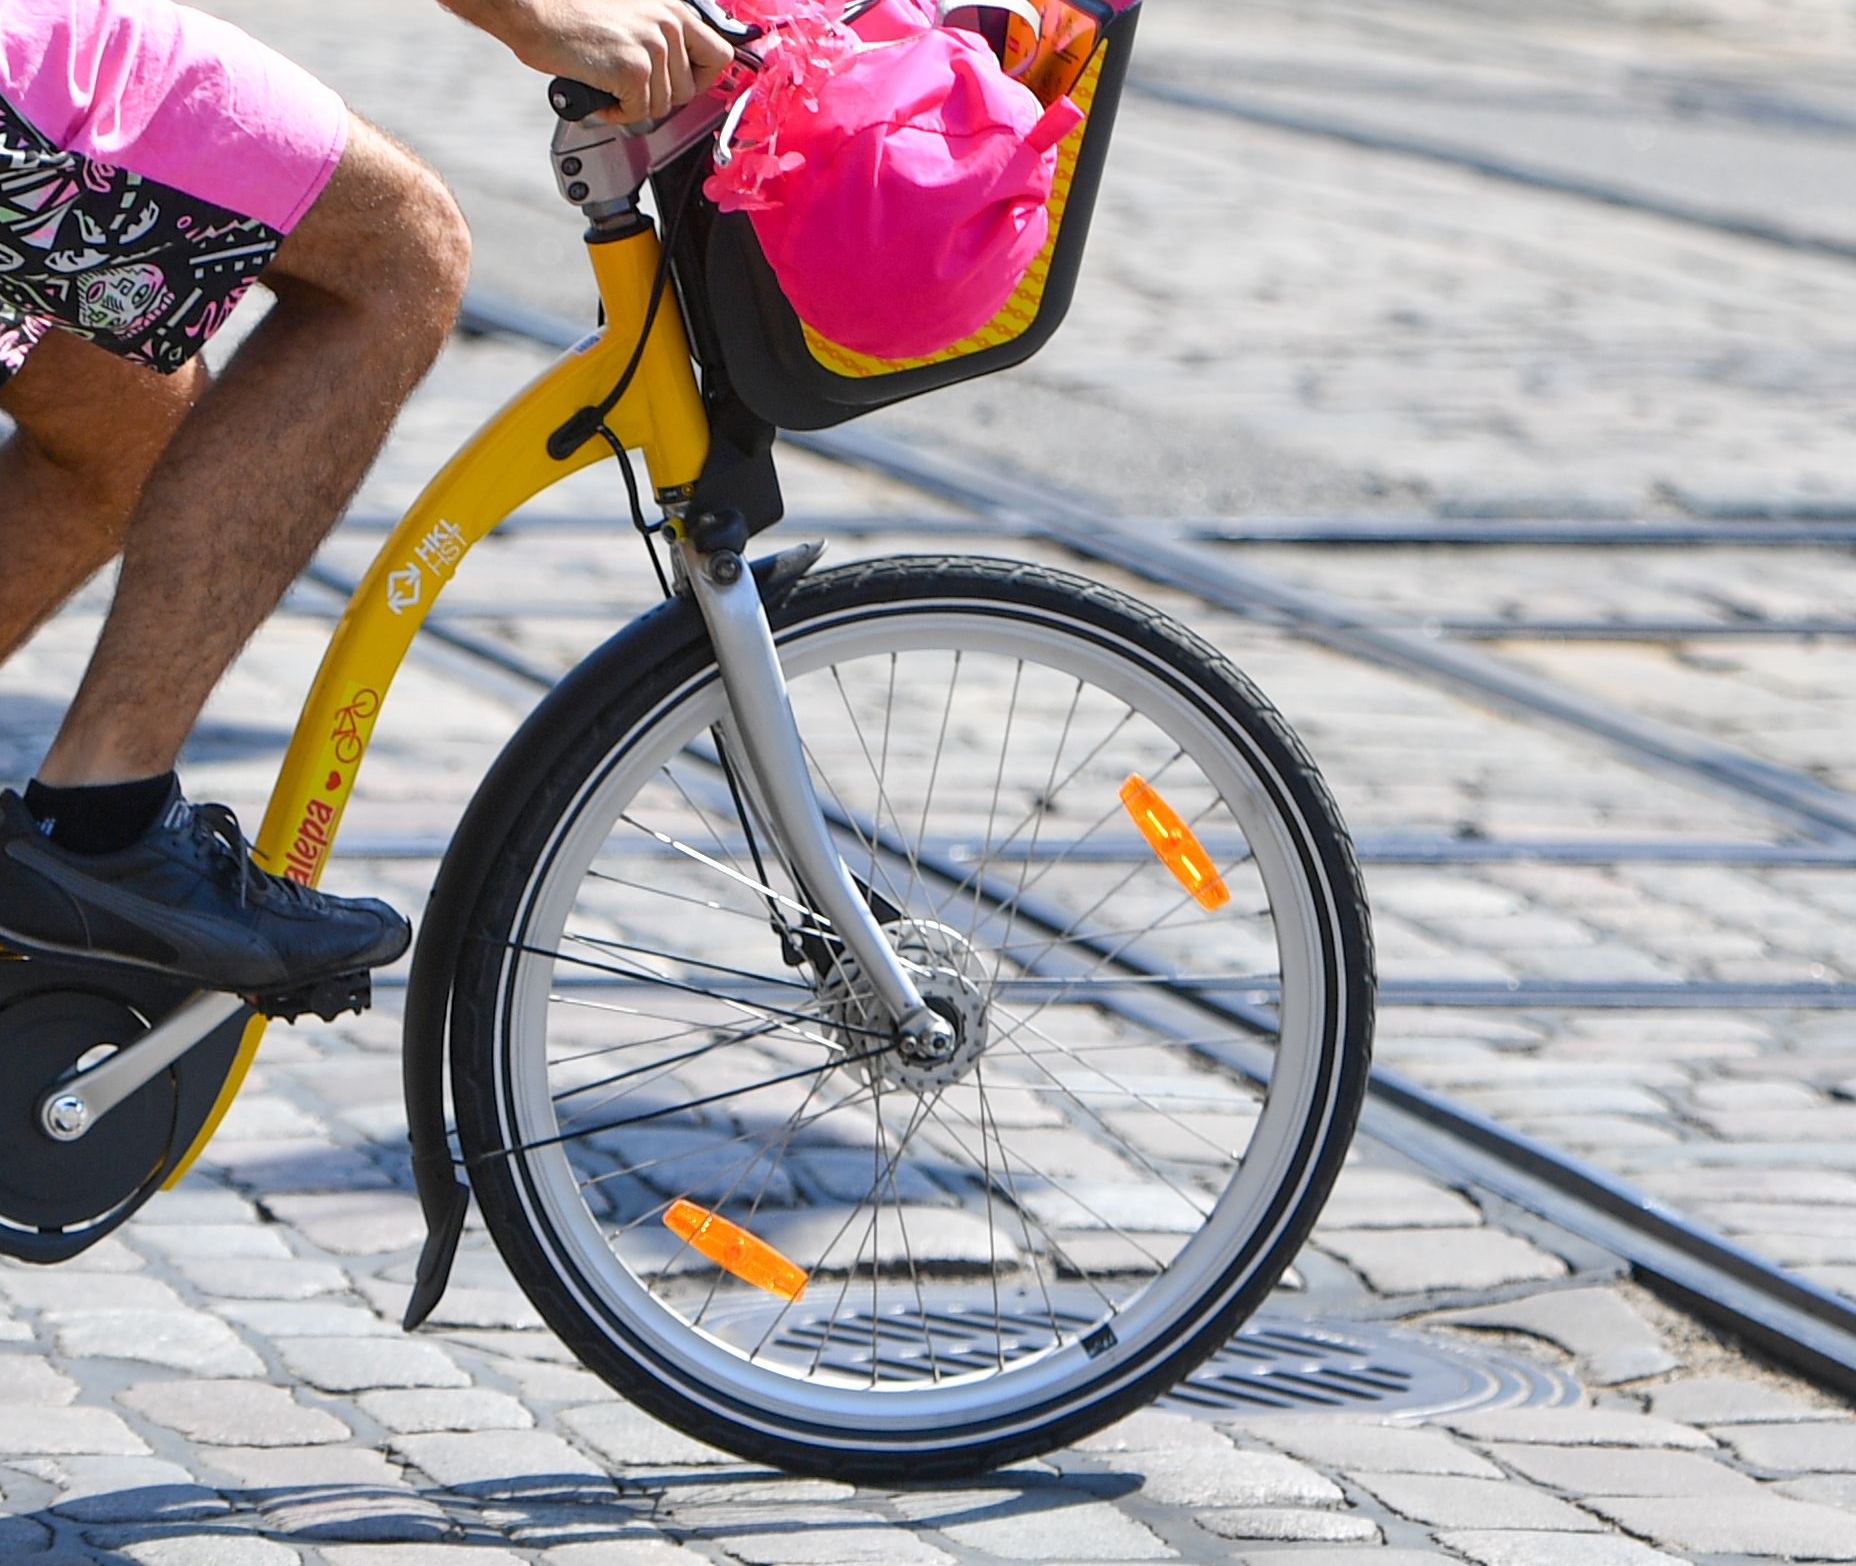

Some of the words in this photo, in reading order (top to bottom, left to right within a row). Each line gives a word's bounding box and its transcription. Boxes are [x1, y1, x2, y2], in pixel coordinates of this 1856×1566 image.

[415, 519, 460, 562] HKL
[427, 525, 467, 576] HST
[284, 799, 335, 888] alepa
